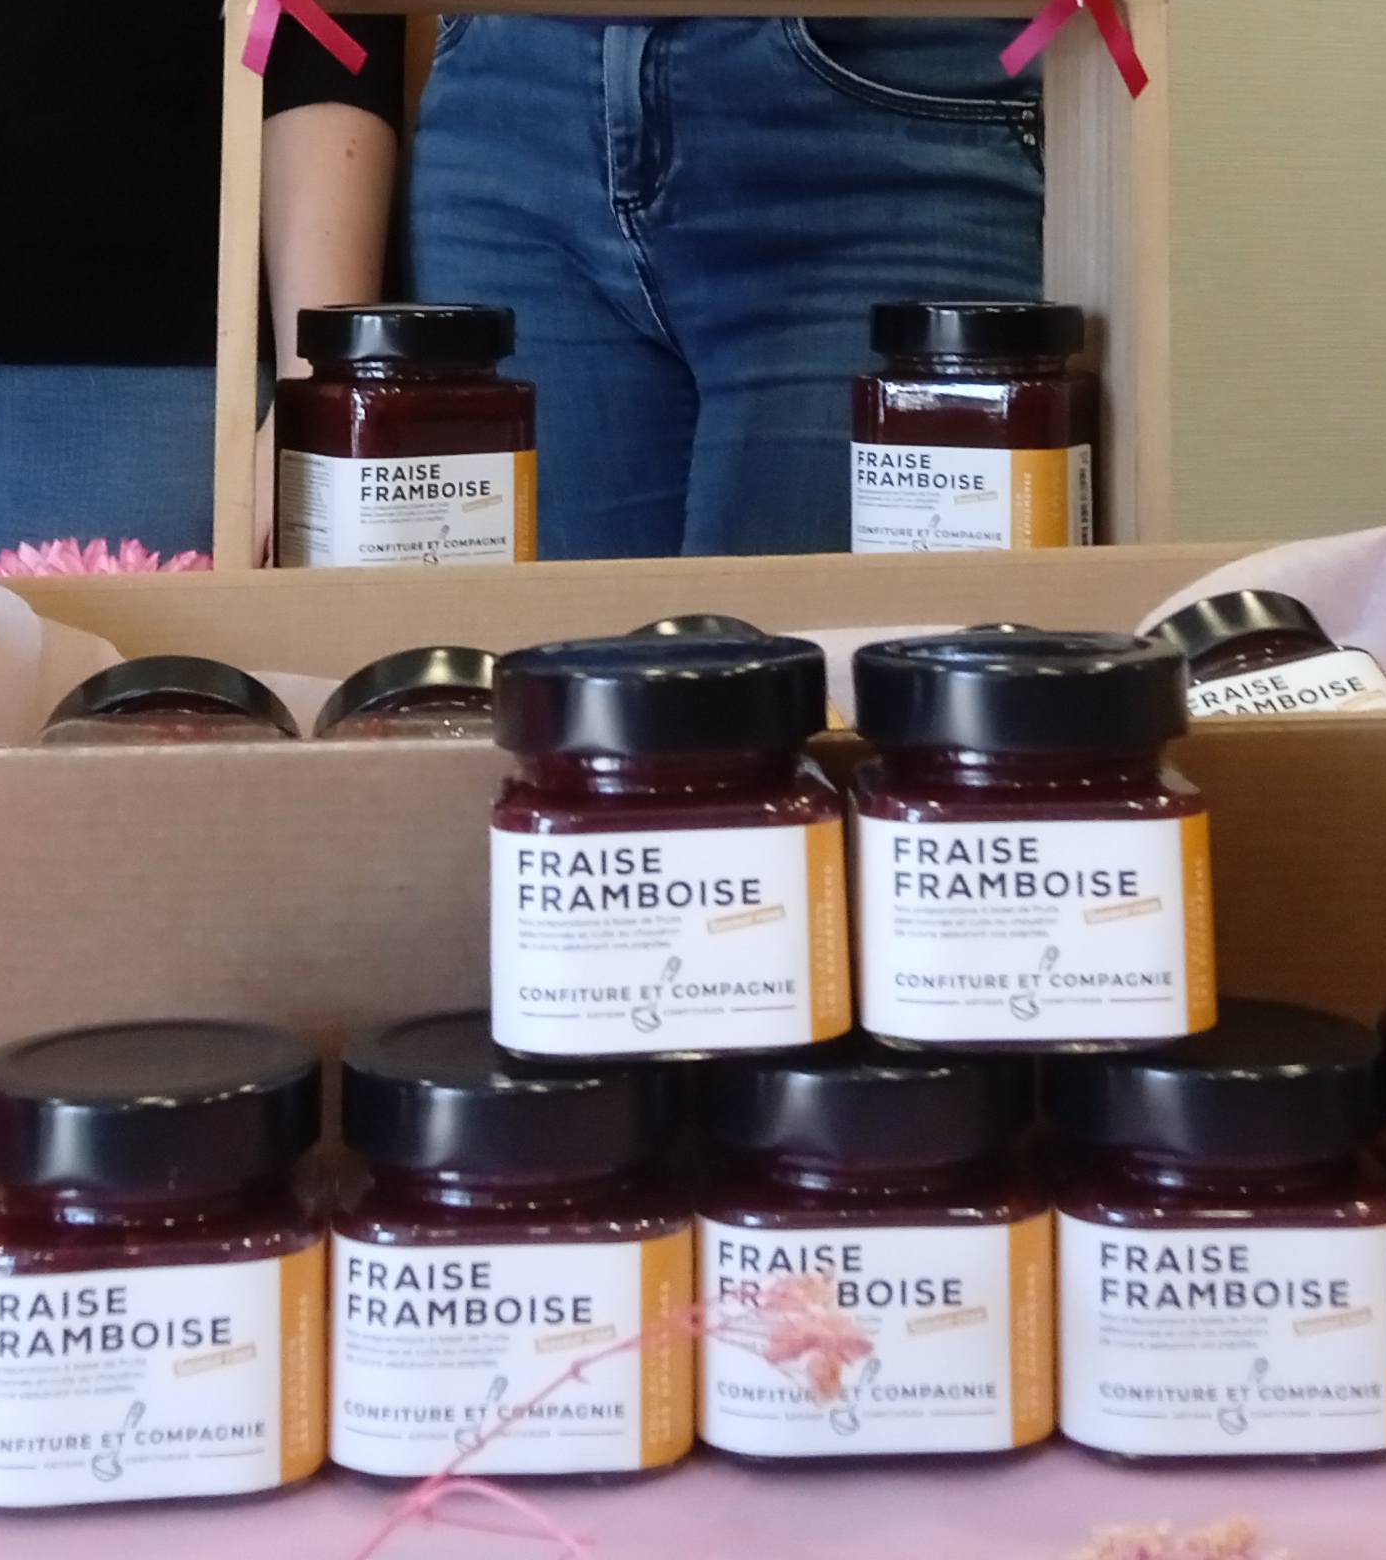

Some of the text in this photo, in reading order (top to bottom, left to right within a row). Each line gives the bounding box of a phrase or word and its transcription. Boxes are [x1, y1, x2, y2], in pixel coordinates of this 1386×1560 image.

[360, 463, 441, 483] FRAISE
[857, 450, 931, 469] FRAISE
[360, 480, 491, 502] FRAMBOISE
[857, 469, 985, 491] FRAMBOISE
[358, 541, 424, 554] CONFITURE
[442, 535, 507, 550] COMPAGNIE
[933, 528, 1002, 542] COMPAGNIE
[517, 846, 663, 879] FRAISE
[892, 835, 1041, 866] FRAISE
[517, 878, 763, 913] FRAMBOISE
[893, 869, 1141, 901] FRAMBOISE
[518, 979, 797, 1003] CONFITURE ET COMPAGNIE
[894, 971, 1174, 990] CONFITURE ET COMPAGNIE
[717, 1239, 864, 1275] FRAISE
[1098, 1241, 1250, 1275] FRAISE
[347, 1256, 492, 1294] FRAISE
[717, 1275, 965, 1310] FRBOISE
[1098, 1274, 1351, 1311] FRAMBOISE
[347, 1292, 593, 1329] FRAMBOISE
[870, 1381, 998, 1402] COMPAGNIE
[1099, 1380, 1383, 1403] CONFITURE ET COMPAGNIE
[344, 1399, 626, 1424] CONFITURE ET COMPAGNIE
[100, 1432, 126, 1451] ET
[134, 1421, 266, 1448] COMPAGNIE
